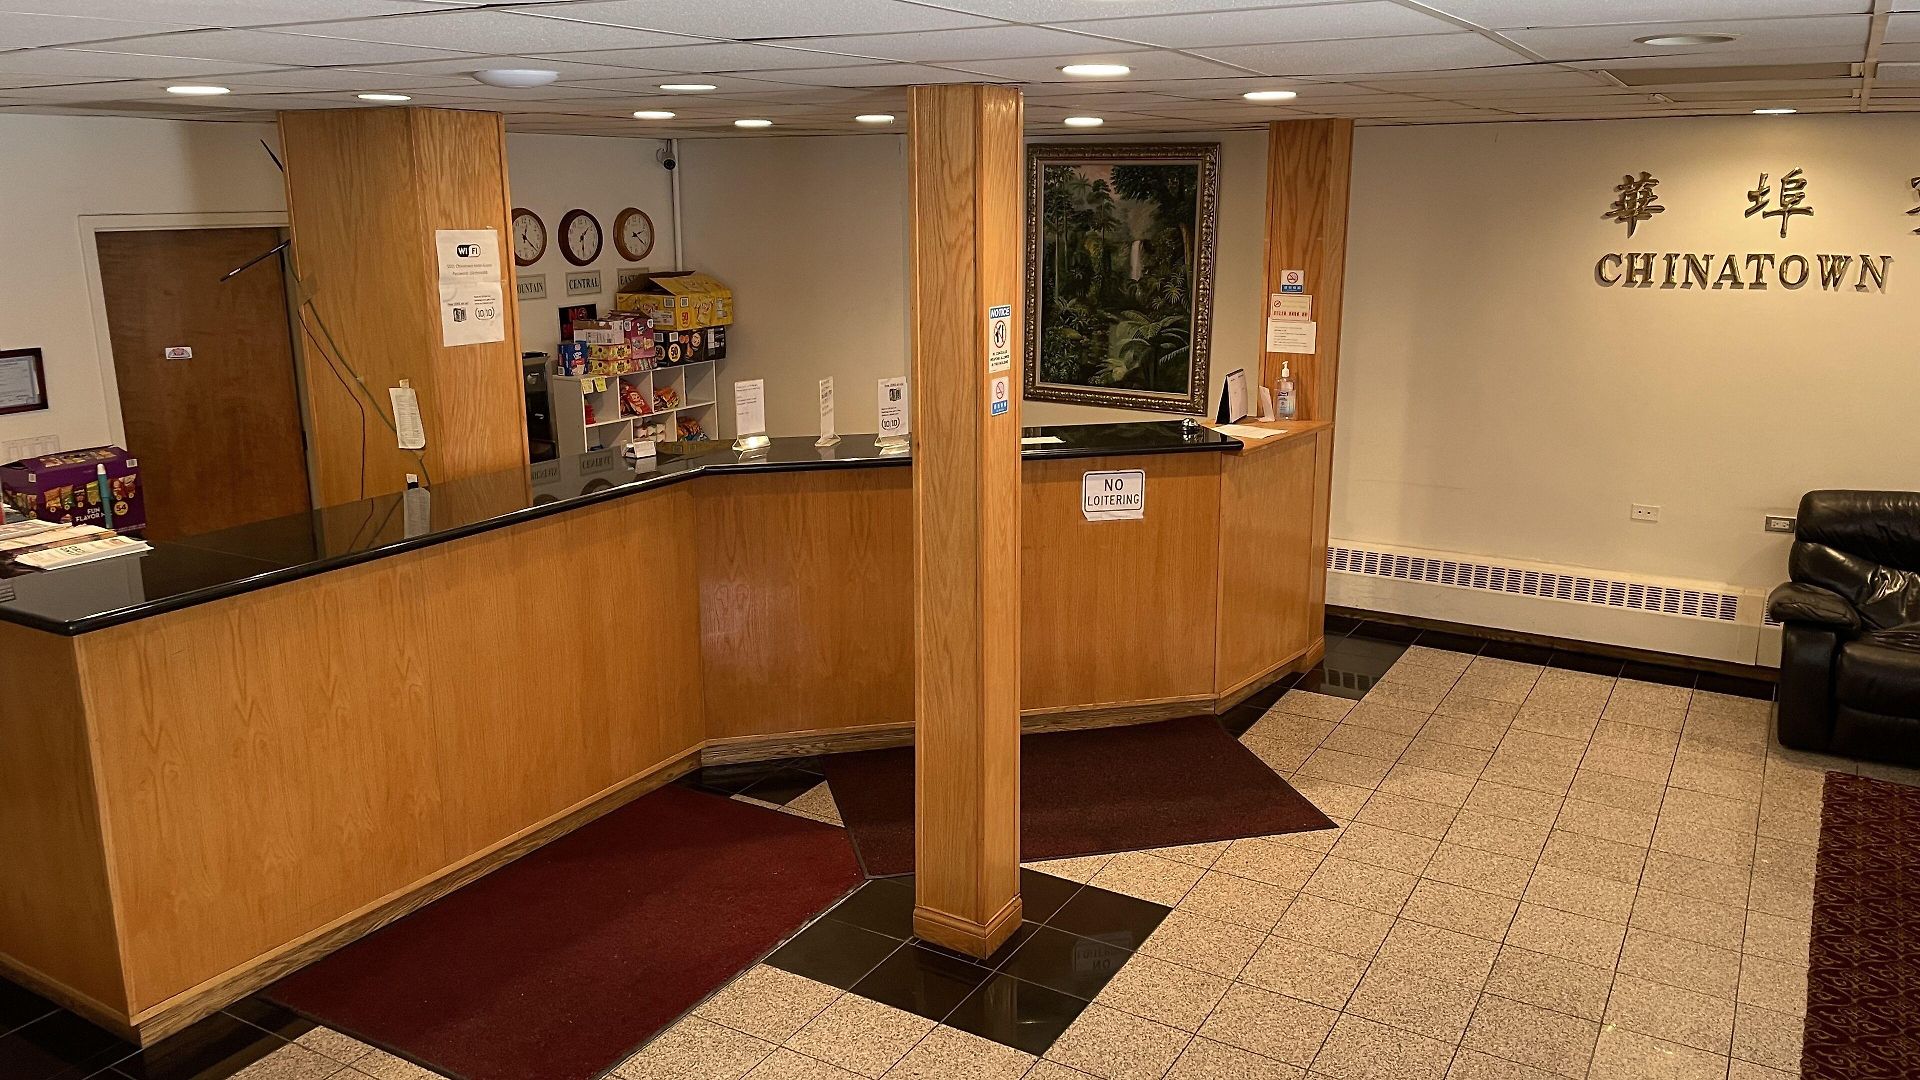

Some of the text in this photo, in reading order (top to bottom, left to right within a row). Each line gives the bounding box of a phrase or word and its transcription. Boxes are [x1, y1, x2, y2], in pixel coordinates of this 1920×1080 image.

[1595, 252, 1893, 293] CHINATOWN
[517, 283, 544, 293] OUNTAIN
[569, 278, 600, 289] CENTRAL
[681, 311, 689, 322] 50
[990, 307, 1010, 318] NOTICE
[670, 346, 679, 356] 50
[1104, 478, 1124, 492] NO
[1087, 494, 1140, 506] LOITERING
[87, 507, 101, 515] FUN
[115, 504, 127, 512] 54
[75, 513, 100, 522] FLAVOR
